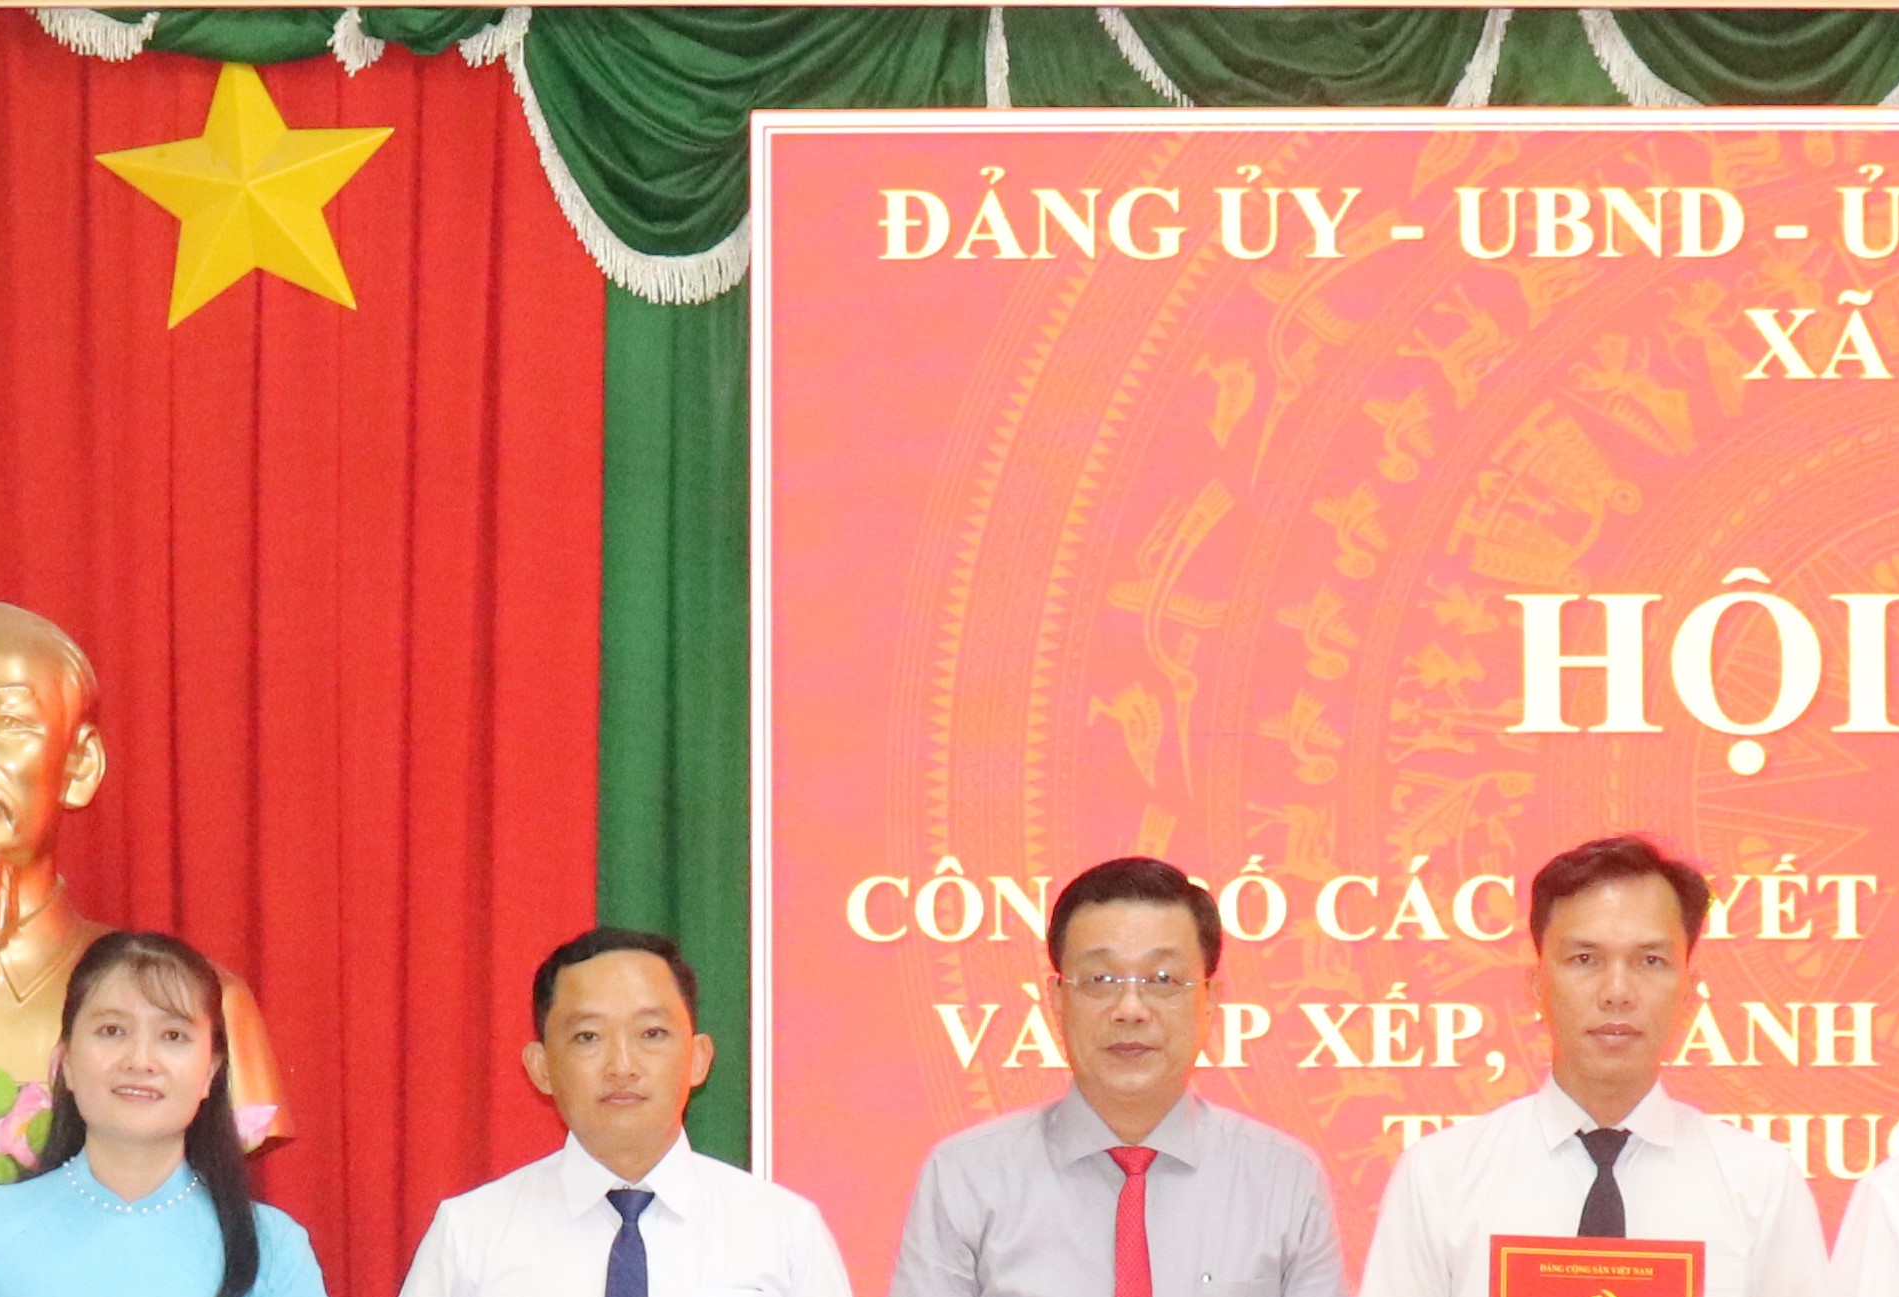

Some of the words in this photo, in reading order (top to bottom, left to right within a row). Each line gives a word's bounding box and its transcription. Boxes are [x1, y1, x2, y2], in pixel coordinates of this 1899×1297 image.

[879, 167, 1186, 260] ĐẢNG
[1215, 165, 1361, 260] ỦY
[1391, 226, 1423, 240] -
[1455, 187, 1744, 260] UBND
[1775, 225, 1807, 239] -
[1742, 292, 1892, 380] XÃ
[846, 856, 1054, 942] CÔN
[1187, 854, 1287, 942] Ố
[1315, 855, 1515, 942] CÁC
[1701, 853, 1877, 940] YẾT
[934, 983, 1070, 1068] VÀ
[1298, 982, 1505, 1083] XẾP,
[1534, 981, 1878, 1067] ÀNH
